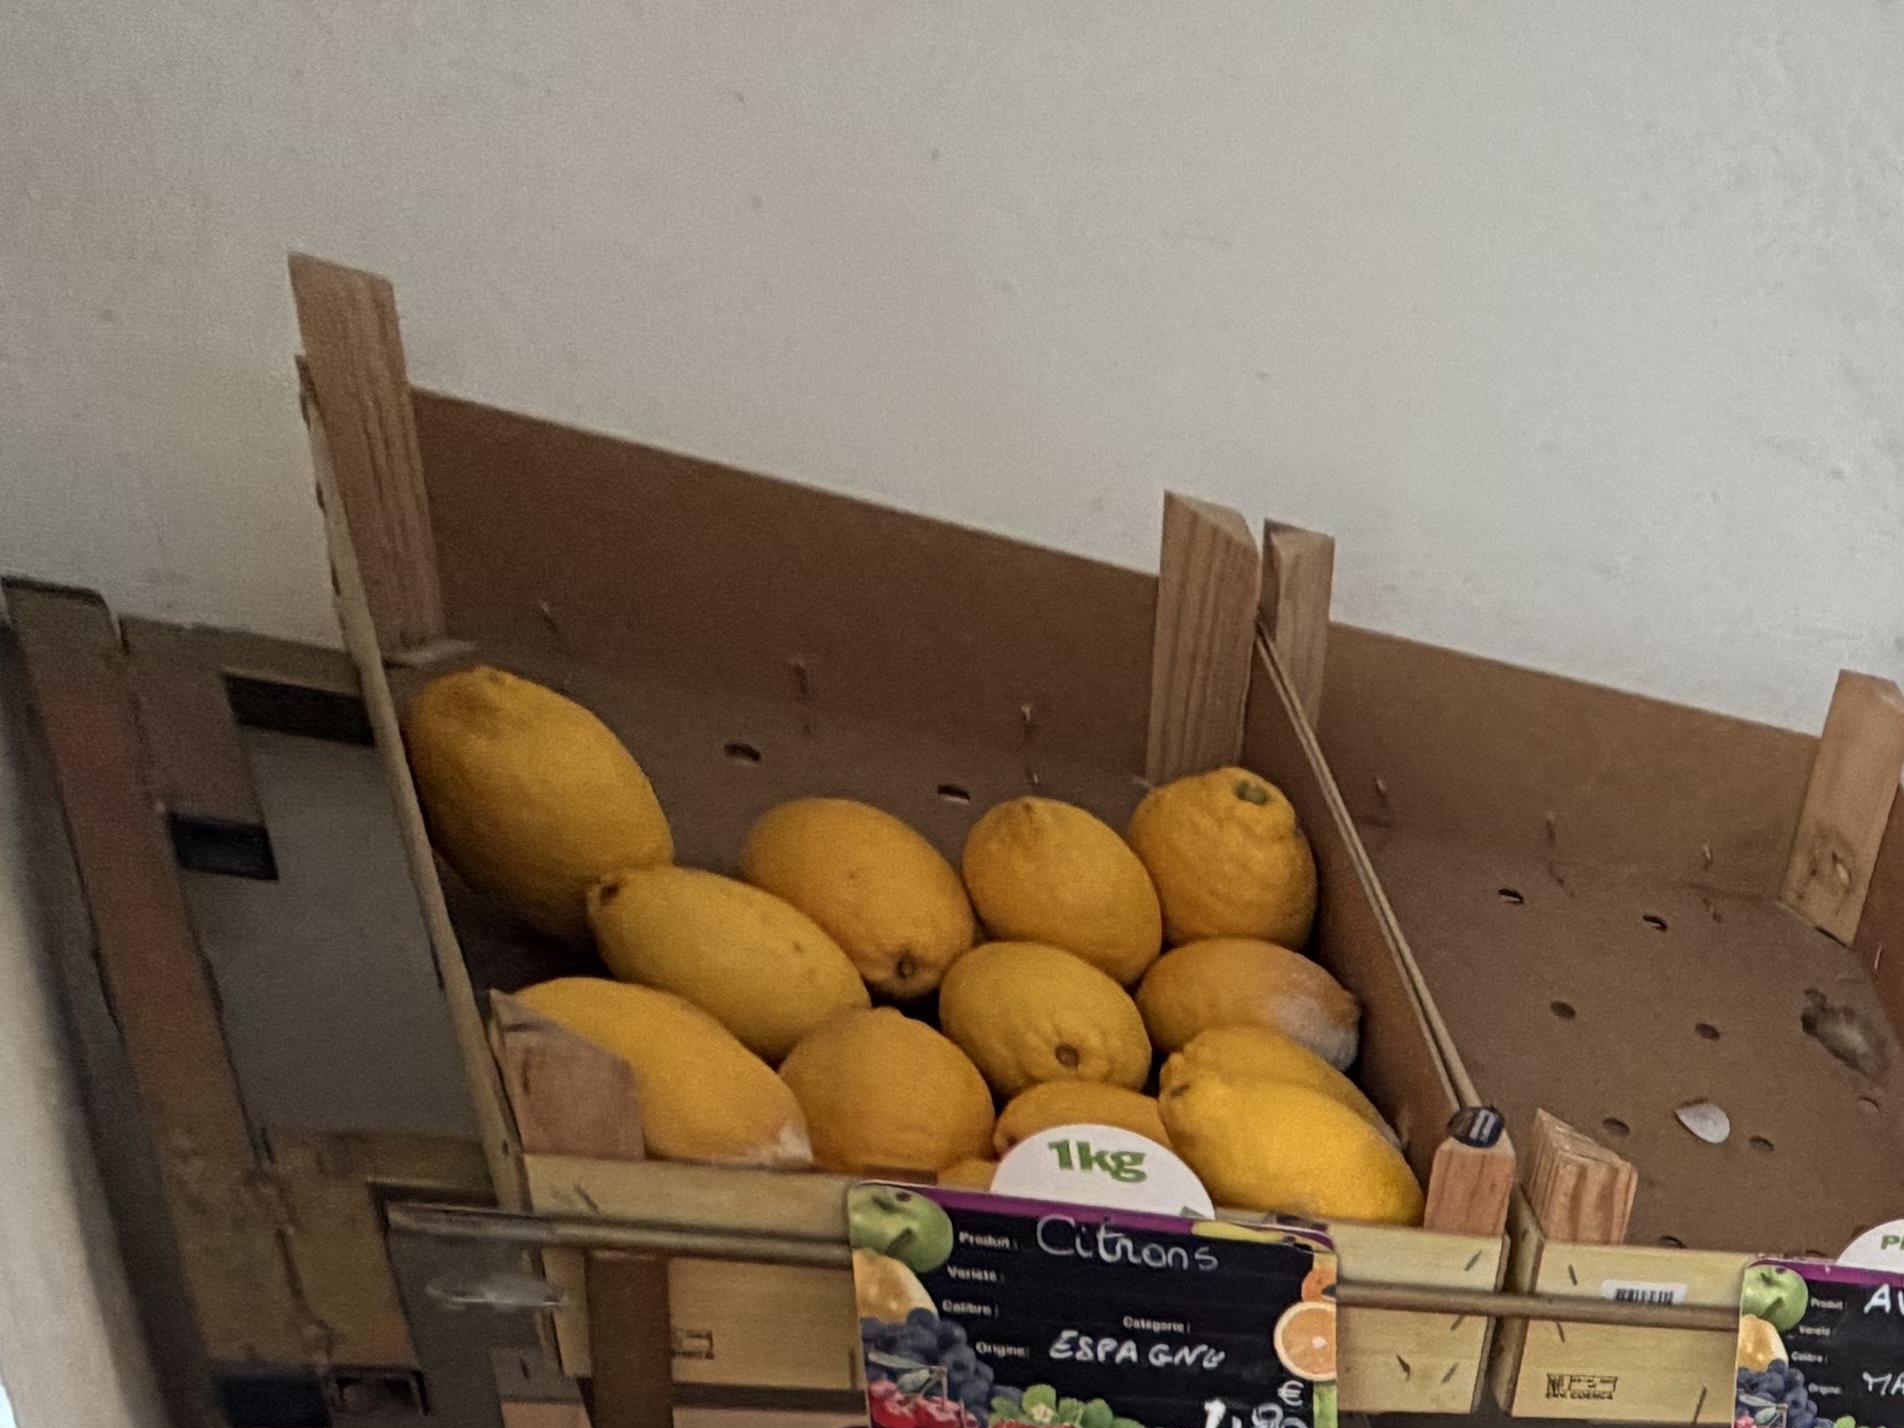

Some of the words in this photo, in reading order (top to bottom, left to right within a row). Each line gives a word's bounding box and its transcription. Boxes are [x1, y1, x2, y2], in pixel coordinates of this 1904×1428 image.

[1048, 1141, 1147, 1183] 1kg
[1037, 1214, 1219, 1273] Citrons
[1050, 1329, 1226, 1368] ESPAGNE
[1278, 1380, 1304, 1406] €
